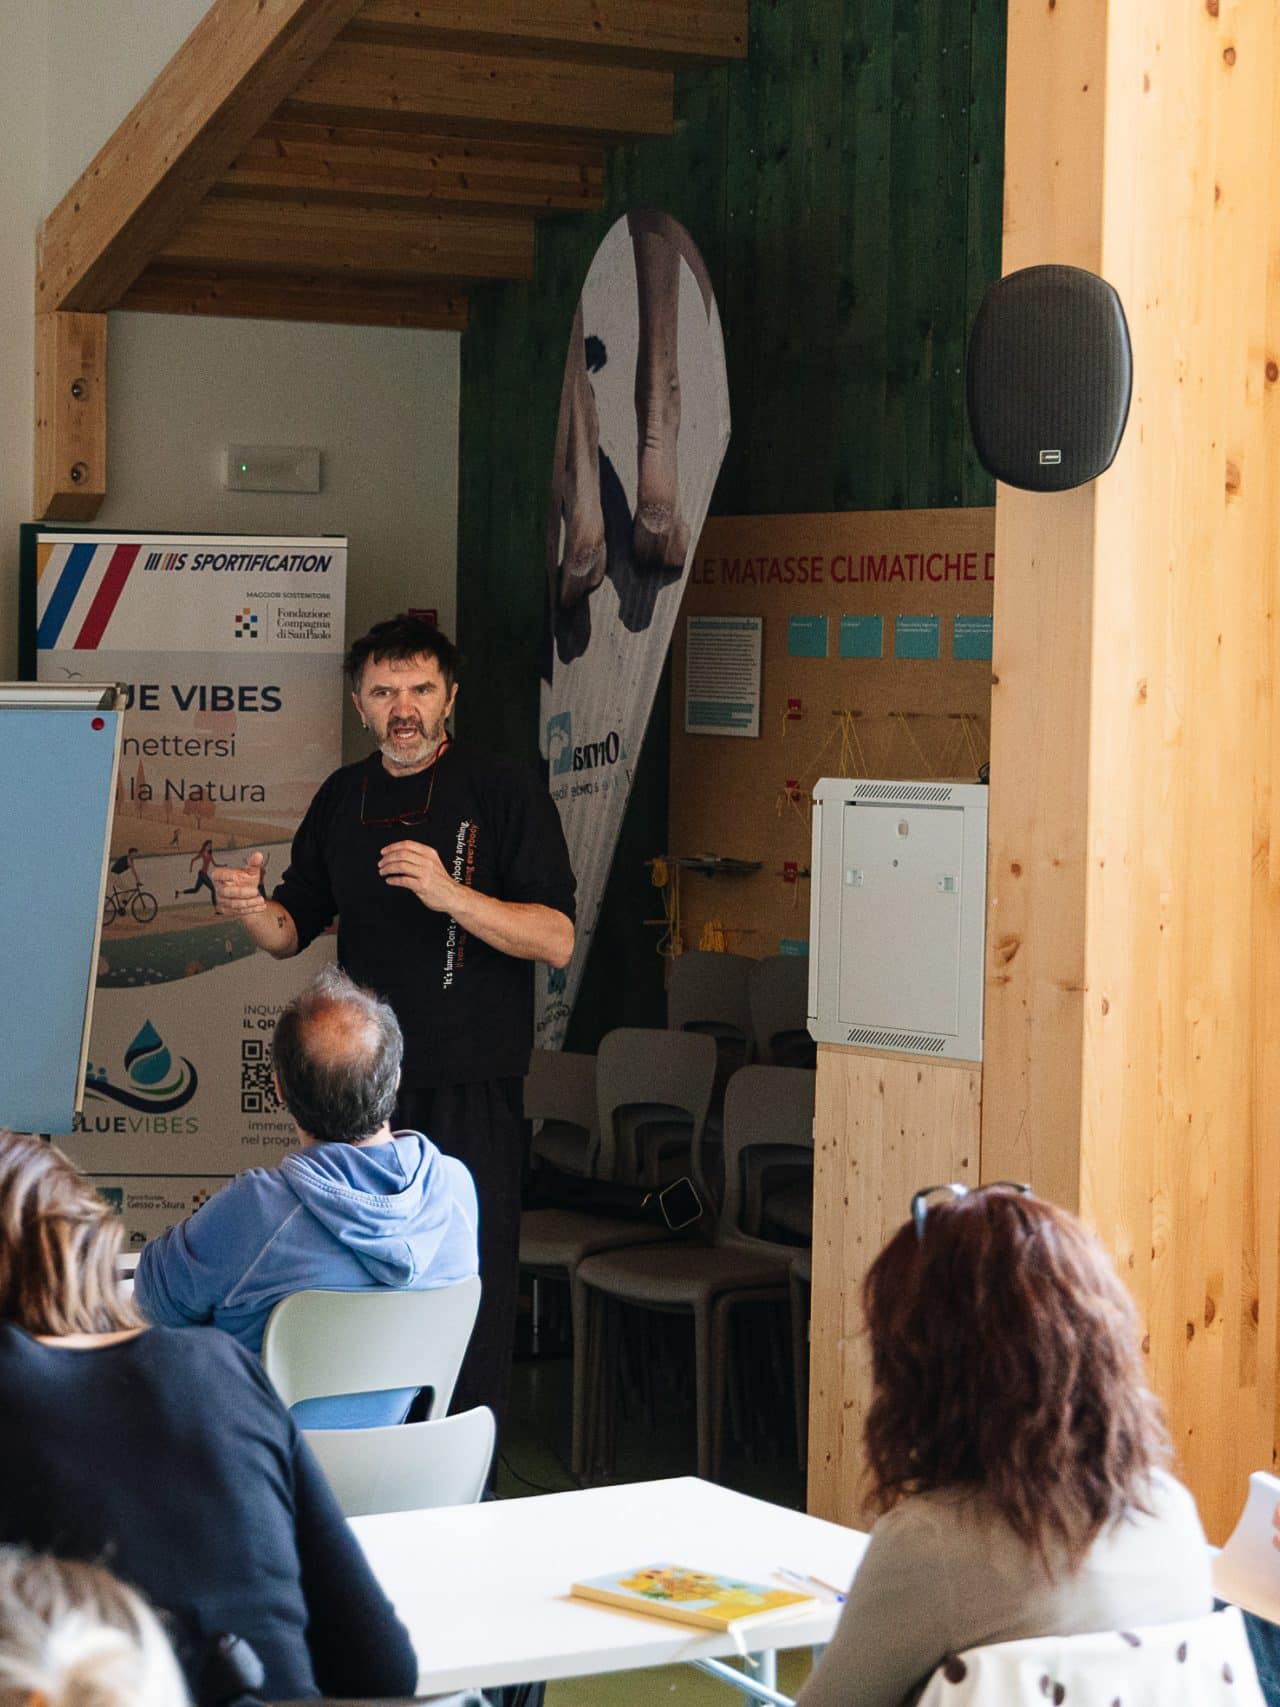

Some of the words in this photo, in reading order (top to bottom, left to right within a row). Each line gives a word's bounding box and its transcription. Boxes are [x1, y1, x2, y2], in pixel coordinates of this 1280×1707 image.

[190, 553, 332, 573] SPORTIFICATION
[721, 556, 824, 585] MATASSE
[830, 553, 977, 583] CLIMATICHE
[277, 608, 331, 618] Fondazione
[277, 619, 331, 629] Compagnia
[171, 684, 283, 713] VIBES
[123, 732, 235, 757] nettersi
[130, 777, 153, 801] la
[165, 778, 266, 802] Natura
[451, 856, 465, 884] ybody
[243, 1004, 288, 1016] INQUA
[243, 1019, 254, 1029] IL
[257, 1019, 276, 1031] QR
[248, 1120, 297, 1134] immerg
[241, 1134, 260, 1145] nel
